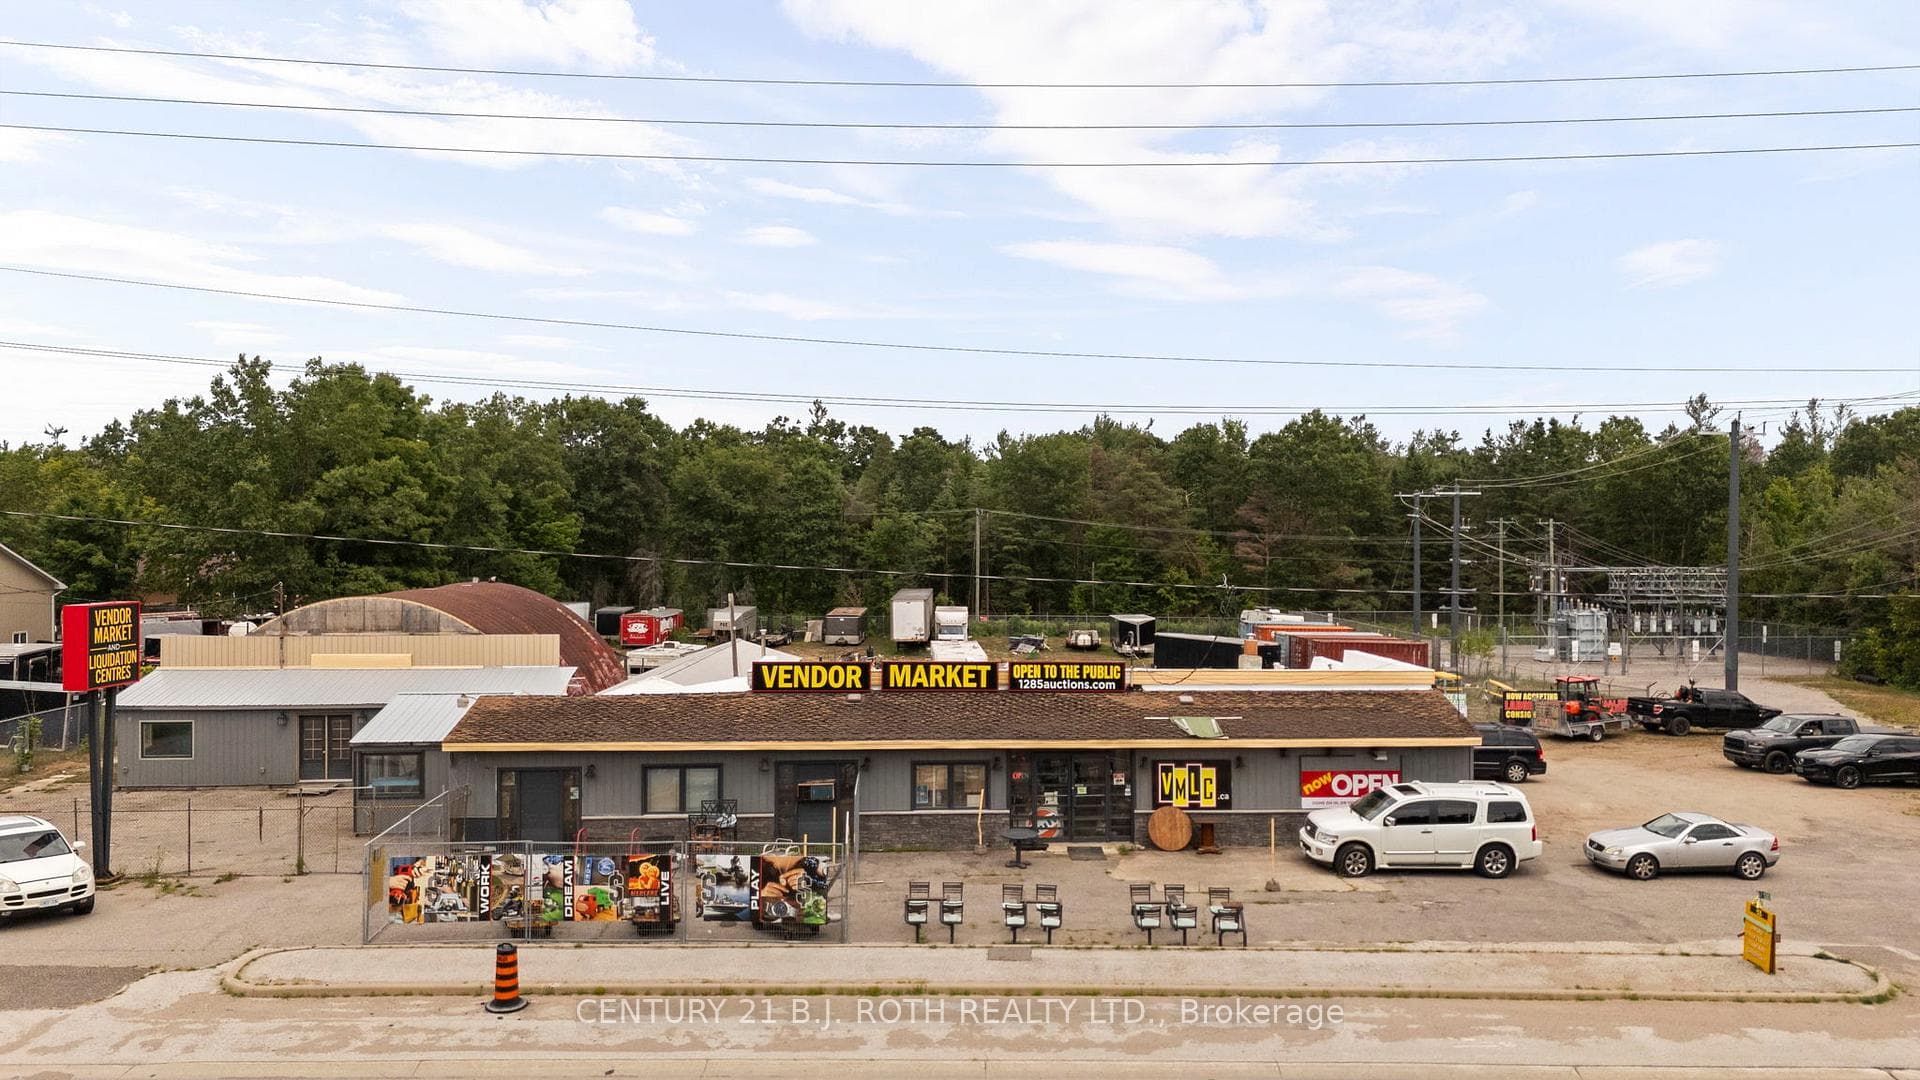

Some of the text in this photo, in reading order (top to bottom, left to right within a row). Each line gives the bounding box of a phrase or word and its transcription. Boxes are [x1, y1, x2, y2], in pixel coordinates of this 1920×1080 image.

[95, 607, 132, 626] VENDOR
[94, 624, 133, 644] MARKET
[107, 643, 120, 651] AND
[89, 649, 137, 670] LIQUIDATION
[95, 665, 131, 684] CENTRES
[761, 665, 862, 688] VENDOR
[889, 664, 991, 688] MARKET
[1013, 664, 1120, 679] OPEN TO THE PUBLIC
[1018, 679, 1116, 690] 1285auctions.com
[1302, 772, 1332, 795] now
[480, 863, 491, 914] WORK
[564, 859, 574, 918] DREAM
[660, 870, 670, 906] LIVE
[750, 869, 760, 911] PLAY
